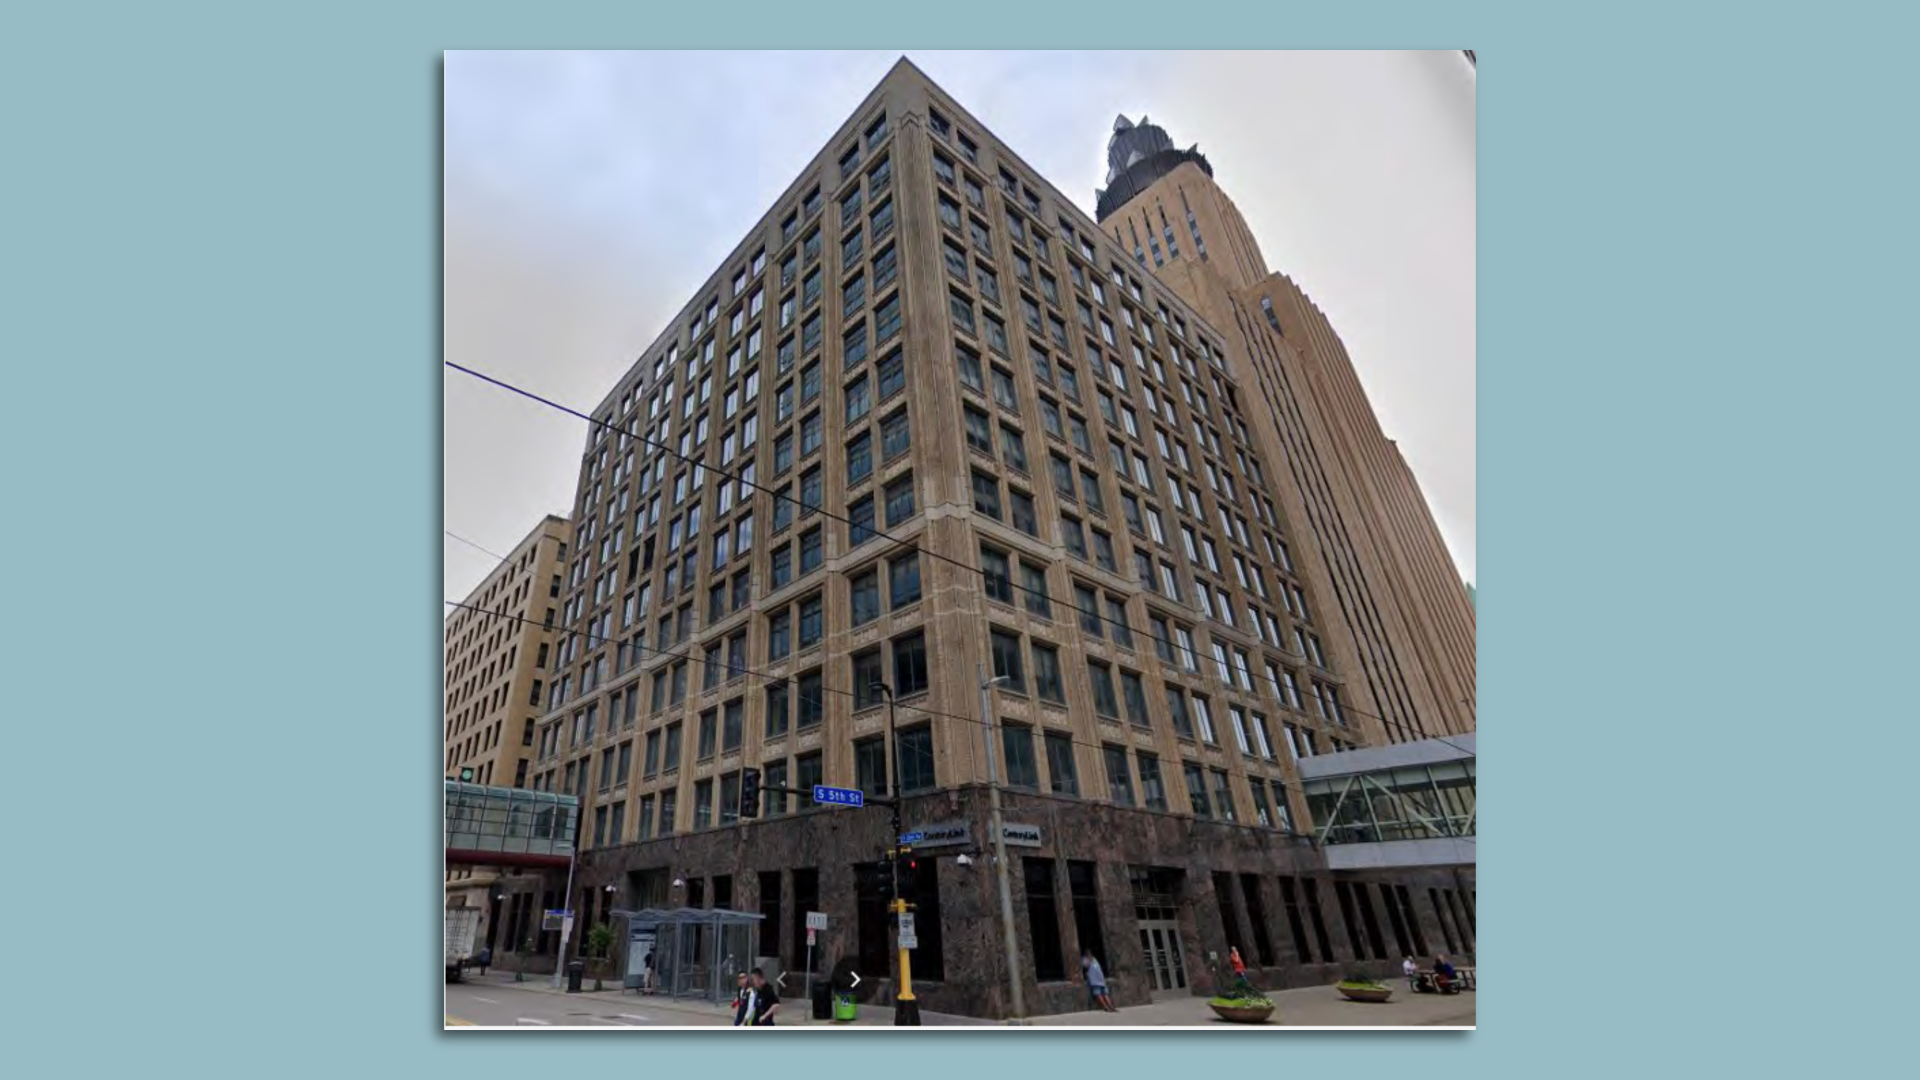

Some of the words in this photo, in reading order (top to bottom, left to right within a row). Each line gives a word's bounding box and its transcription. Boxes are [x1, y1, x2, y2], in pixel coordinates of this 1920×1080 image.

[817, 788, 824, 799] S
[828, 790, 846, 801] 5th
[849, 792, 860, 803] St
